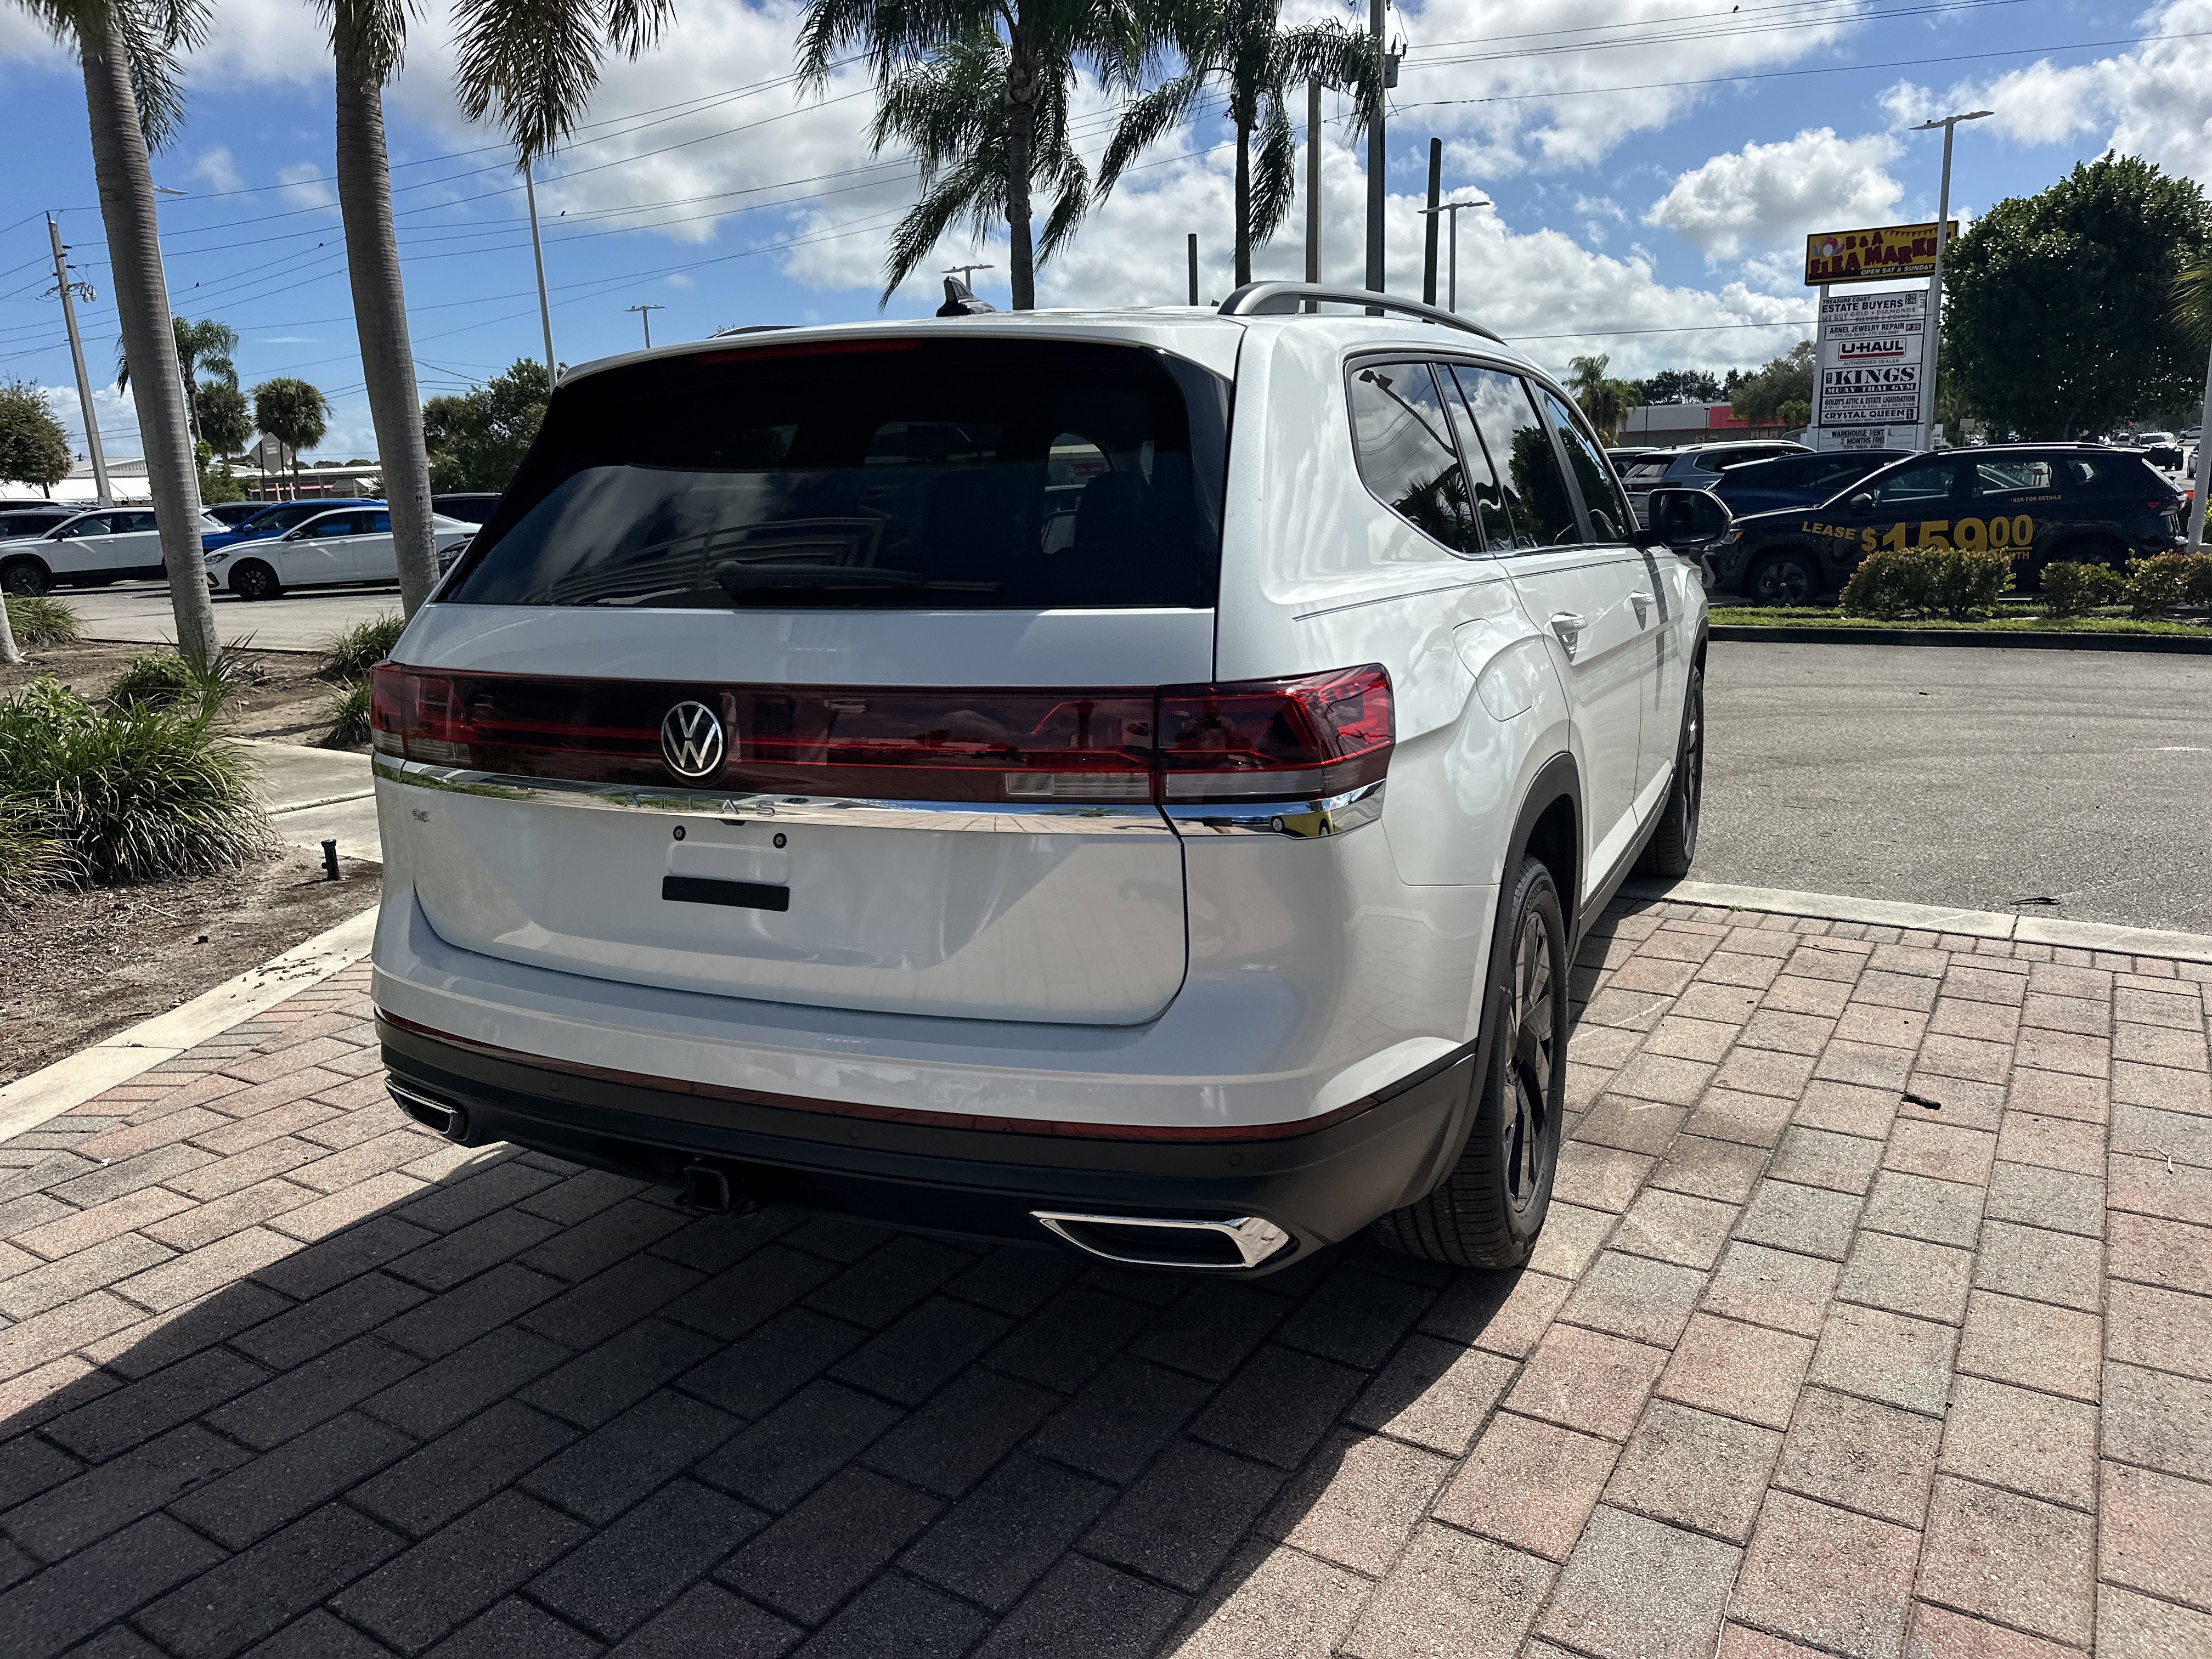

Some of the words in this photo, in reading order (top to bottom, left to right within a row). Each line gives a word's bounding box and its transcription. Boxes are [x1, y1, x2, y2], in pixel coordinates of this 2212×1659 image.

[1846, 236, 1857, 250] B
[1859, 235, 1869, 247] &
[1871, 231, 1884, 246] A
[1810, 252, 1861, 279] FLEA
[1904, 264, 1934, 272] SUNDAY
[1822, 303, 1859, 313] ESTATE
[1861, 299, 1903, 311] BUYERS
[1834, 312, 1849, 321] BUY
[1876, 307, 1916, 315] DIAMONDS
[1829, 325, 1849, 334] ARNEL
[1850, 324, 1880, 333] JEWELRY
[1881, 323, 1905, 331] REPAIR
[1841, 340, 1904, 354] U-HAUL
[1834, 367, 1915, 385] KINGS
[1826, 386, 1857, 394] MUAY
[1865, 396, 1882, 404] ESTATE
[1882, 395, 1916, 404] LIQUIDATION
[1825, 411, 1866, 419] CRYSTAL
[1869, 409, 1905, 417] QUEEN
[1832, 430, 1867, 438] WAREHOUSE
[1869, 428, 1892, 437] RENTL
[1802, 521, 1857, 540] LEASE
